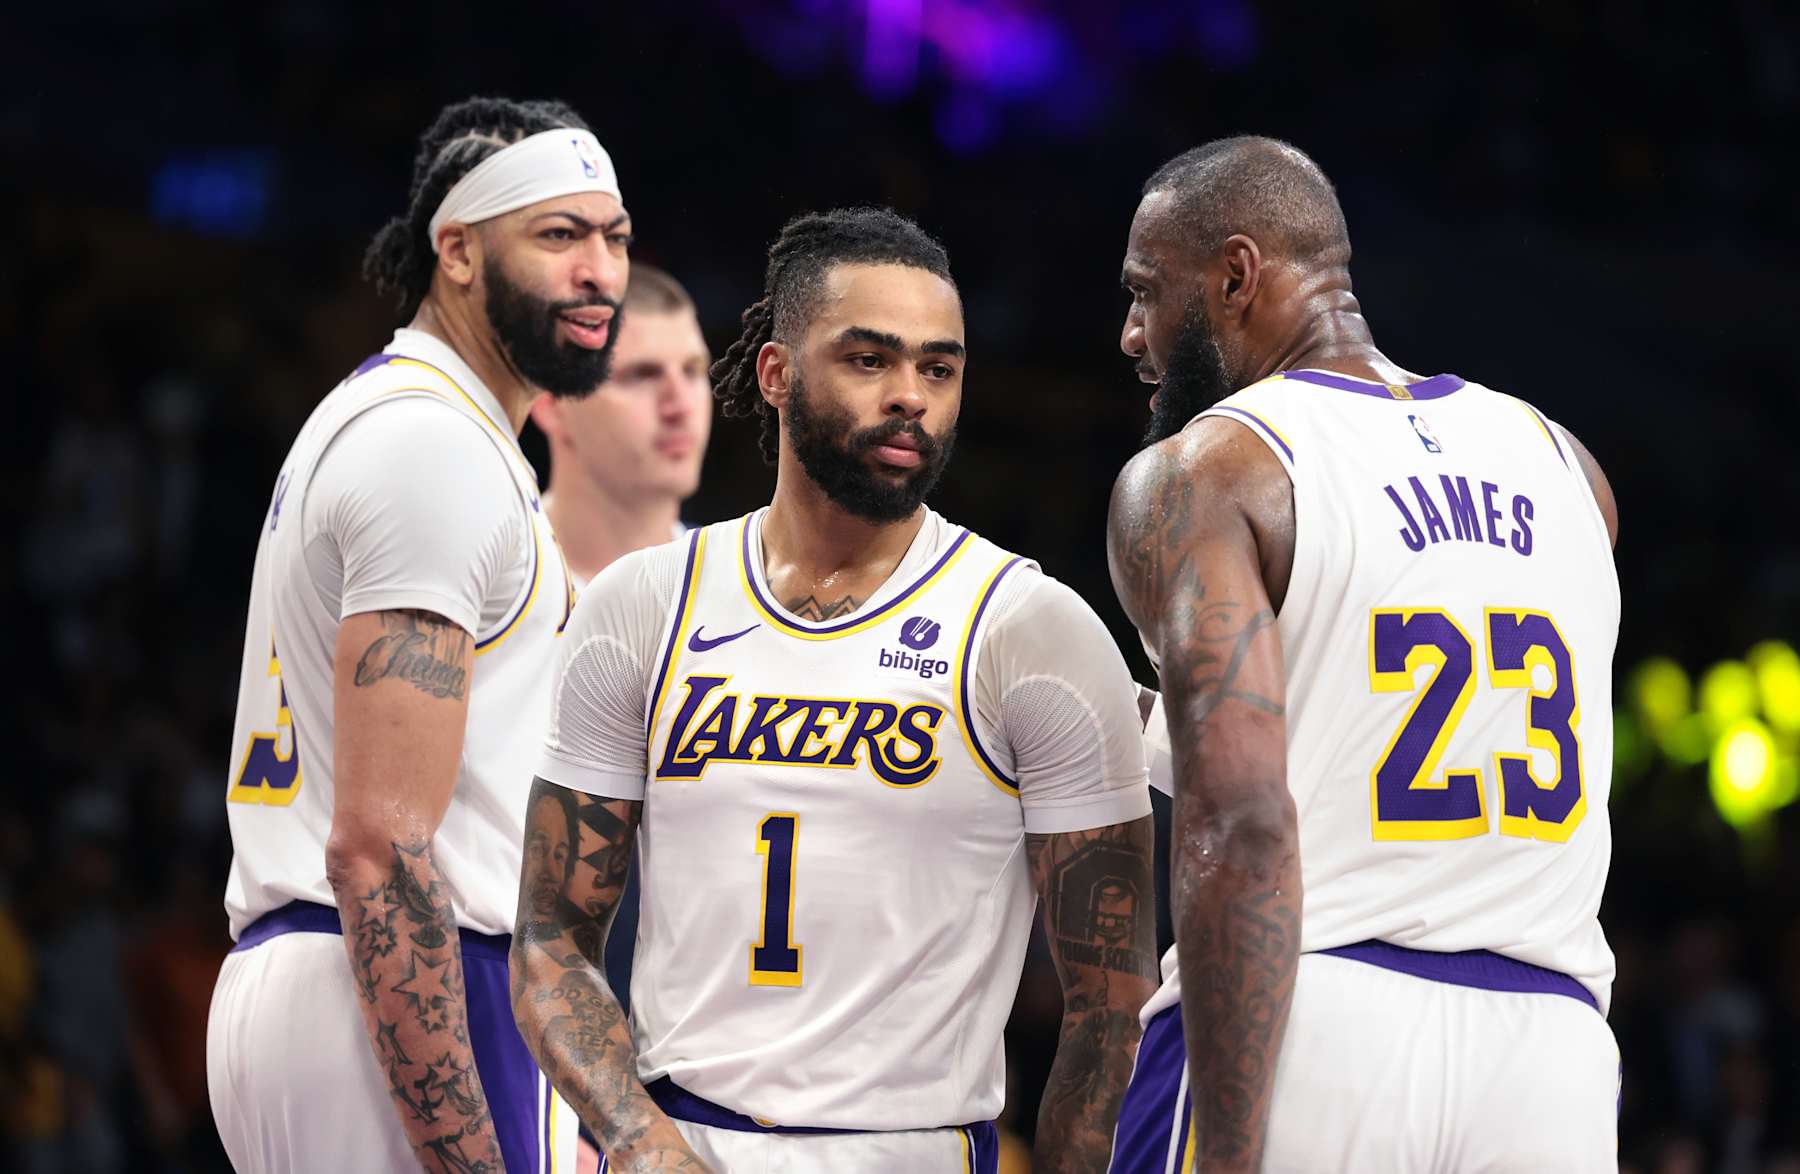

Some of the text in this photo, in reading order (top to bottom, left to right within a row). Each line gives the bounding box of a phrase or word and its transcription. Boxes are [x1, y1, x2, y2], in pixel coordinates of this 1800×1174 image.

[1384, 474, 1535, 557] JAMES
[879, 648, 949, 679] bibigo
[655, 674, 943, 788] LAKERS
[1369, 606, 1588, 842] 23
[749, 812, 803, 987] 1
